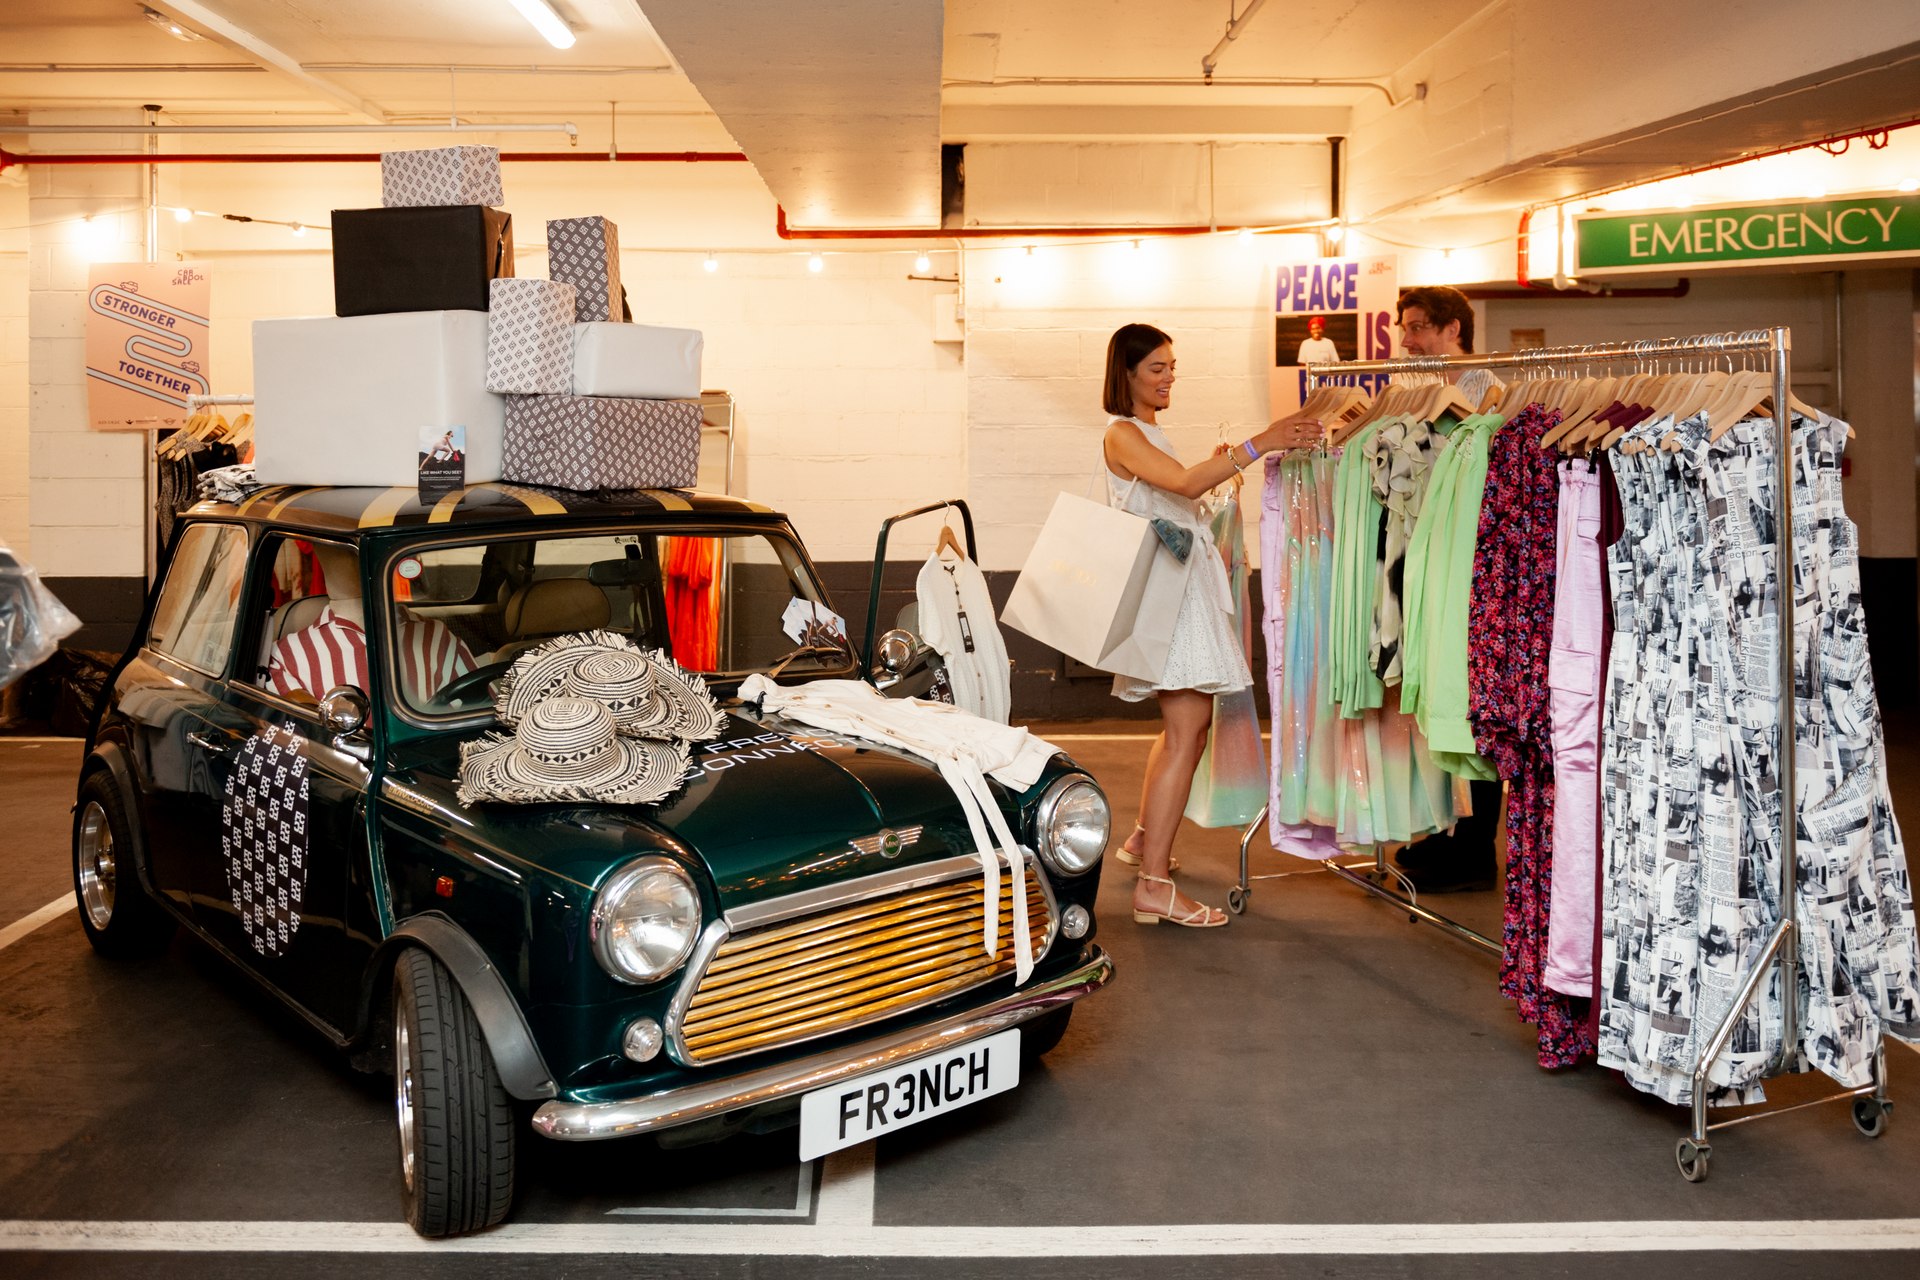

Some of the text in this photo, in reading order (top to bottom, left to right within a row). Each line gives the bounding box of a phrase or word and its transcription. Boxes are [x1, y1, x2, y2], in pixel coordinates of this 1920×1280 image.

[1629, 206, 1901, 257] EMERGENCY
[103, 295, 176, 328] STRONGER
[1275, 263, 1359, 312] PEACE
[1365, 311, 1392, 361] IS
[118, 360, 191, 394] TOGETHER
[704, 728, 834, 754] FRENC
[838, 1047, 990, 1140] FR3NCH
